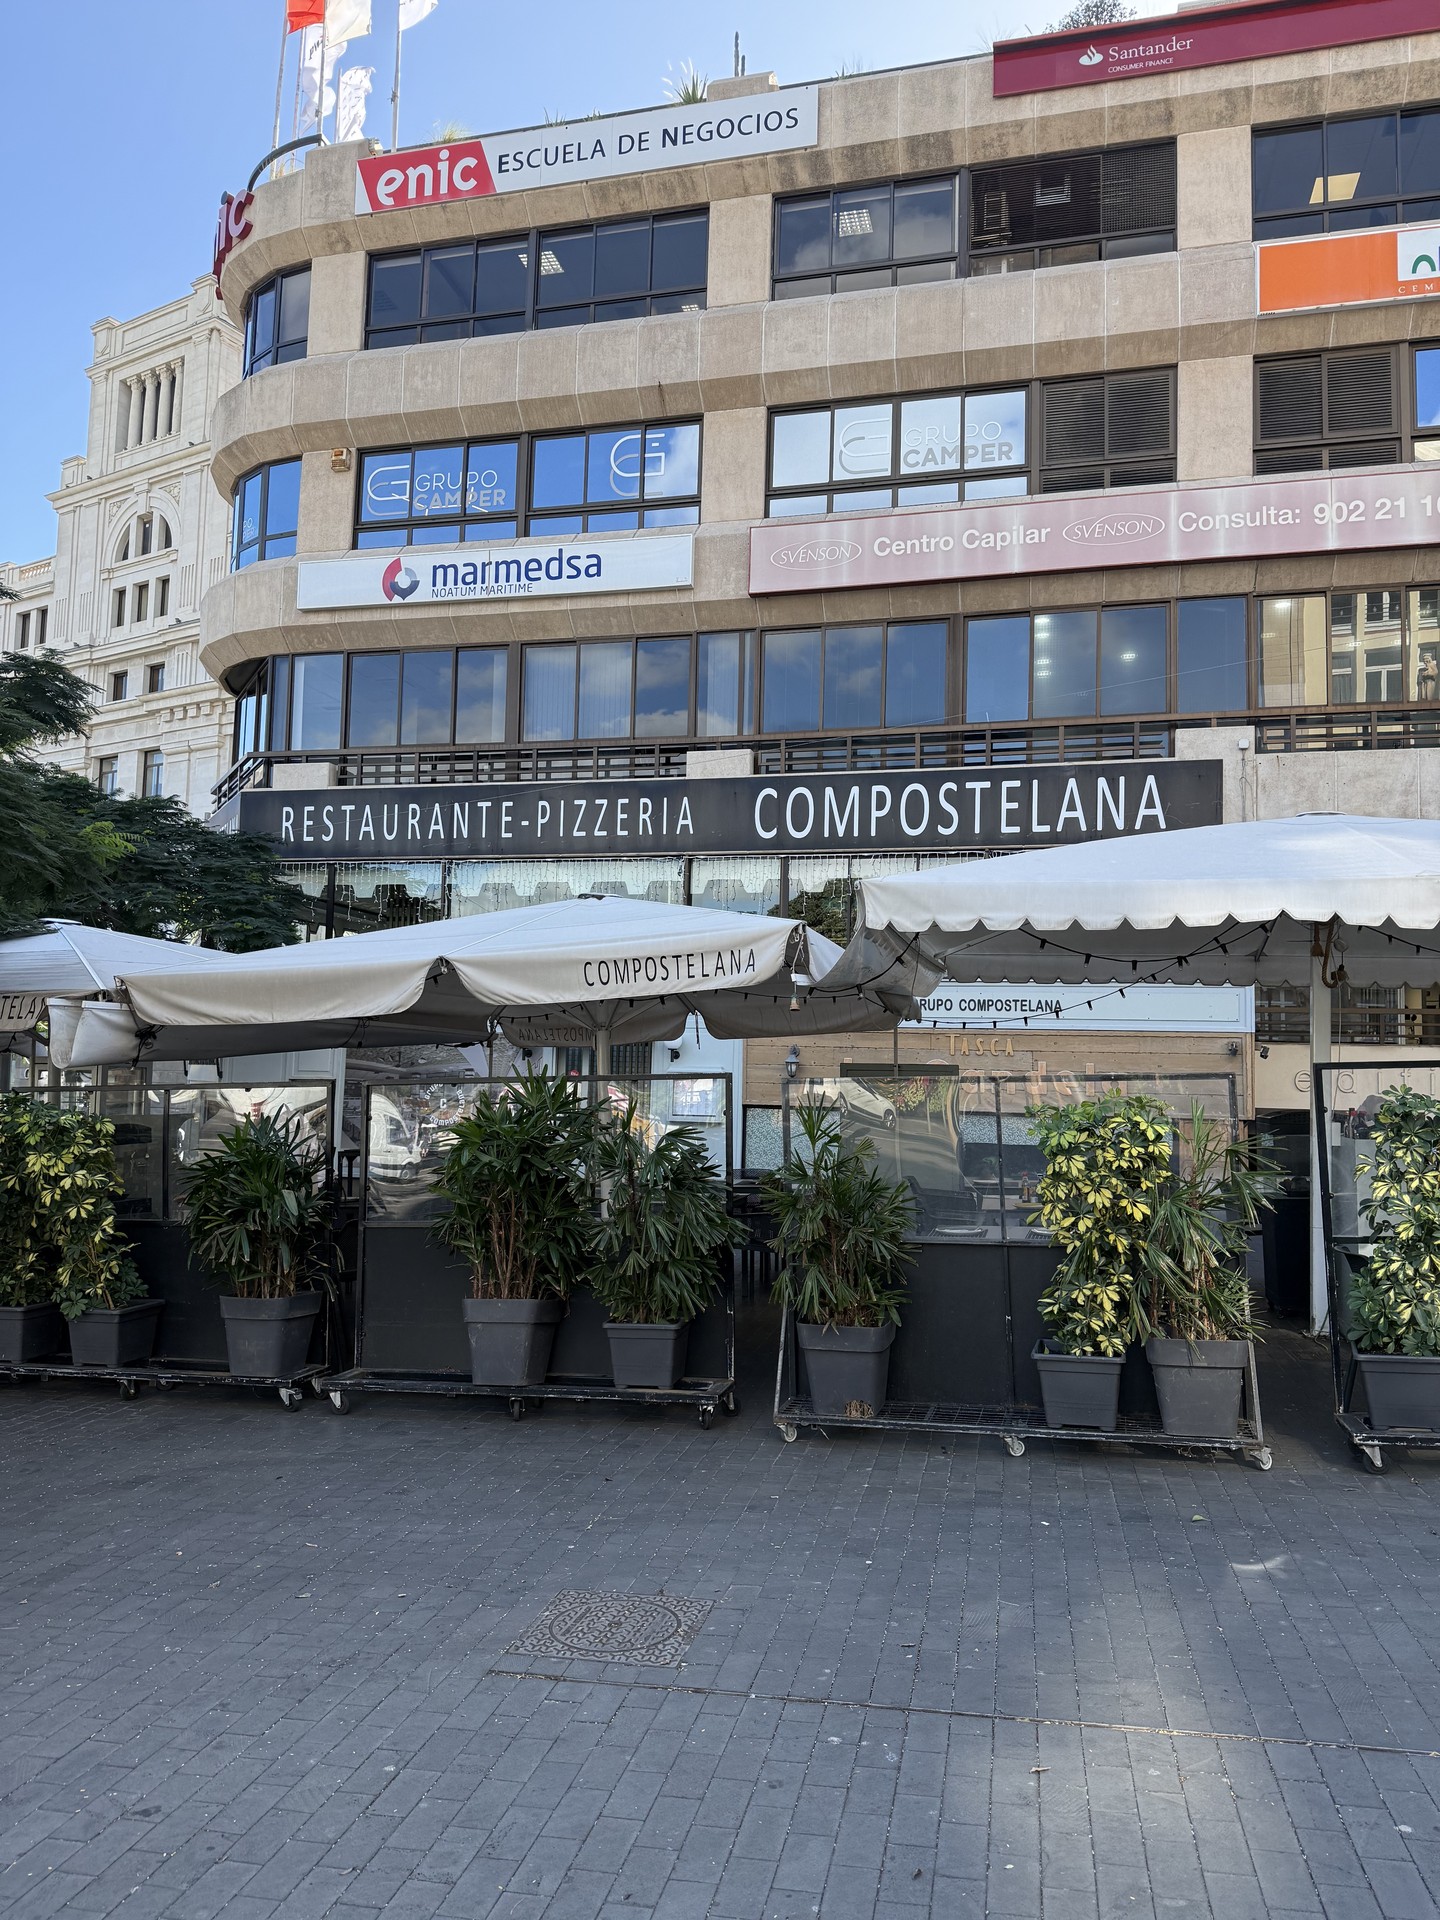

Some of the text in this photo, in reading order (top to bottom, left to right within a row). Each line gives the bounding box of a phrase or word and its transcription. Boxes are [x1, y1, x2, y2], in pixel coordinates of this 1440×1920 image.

[1108, 36, 1194, 62] Santander
[1107, 57, 1174, 74] CONSUMER FINANCE
[376, 107, 799, 206] enic ESCUELA DE NEGOCIOS
[904, 421, 1002, 448] GRUPO
[902, 441, 1014, 469] CAMPER
[415, 469, 498, 492] GRUPO
[413, 488, 506, 511] CAMPER
[779, 494, 1440, 565] SVENSON Centro Capilar SVENSON Consulta: 902 21 1
[431, 548, 602, 588] marmedsa
[431, 582, 534, 599] NOATUM MARITIME
[281, 774, 1167, 842] RESTAURANTE-PIZZERIA COMPOSTELANA
[583, 948, 756, 987] COMPOSTELANA
[918, 998, 1063, 1013] RUPO COMPOSTELANA
[945, 1034, 1015, 1057] TASCA
